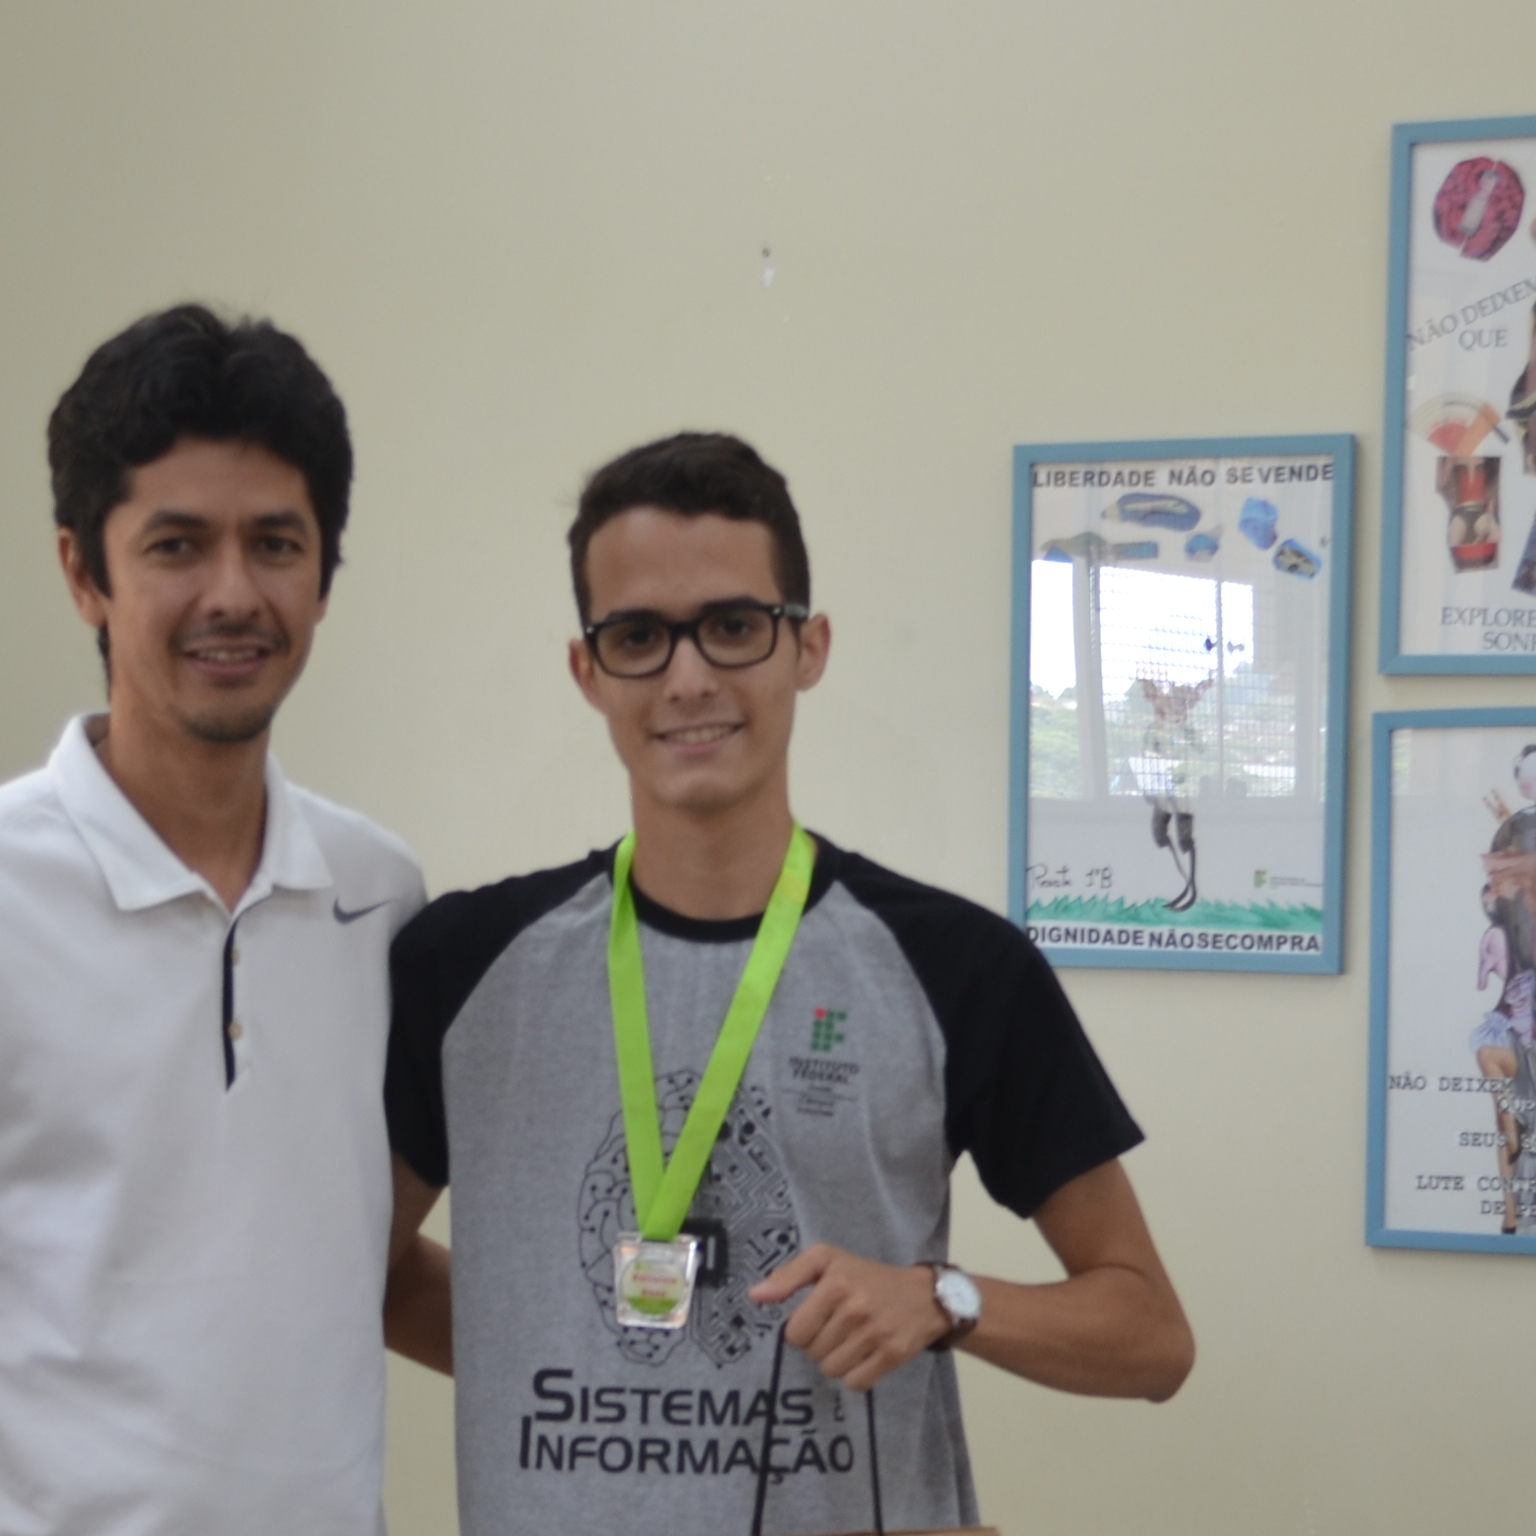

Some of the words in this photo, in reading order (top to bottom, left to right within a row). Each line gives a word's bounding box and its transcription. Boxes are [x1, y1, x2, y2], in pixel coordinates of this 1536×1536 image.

[1407, 314, 1458, 350] NÃO
[1458, 328, 1507, 350] QUE
[1033, 468, 1155, 488] LIBERDADE
[1168, 464, 1215, 487] NÃO
[1027, 925, 1144, 946] DIGNIDADE
[1389, 1073, 1426, 1091] NÃO
[1438, 1077, 1514, 1093] DEIXEM
[1459, 1132, 1507, 1147] SEUS
[1416, 1174, 1465, 1191] LUTE
[1480, 1200, 1505, 1215] DE
